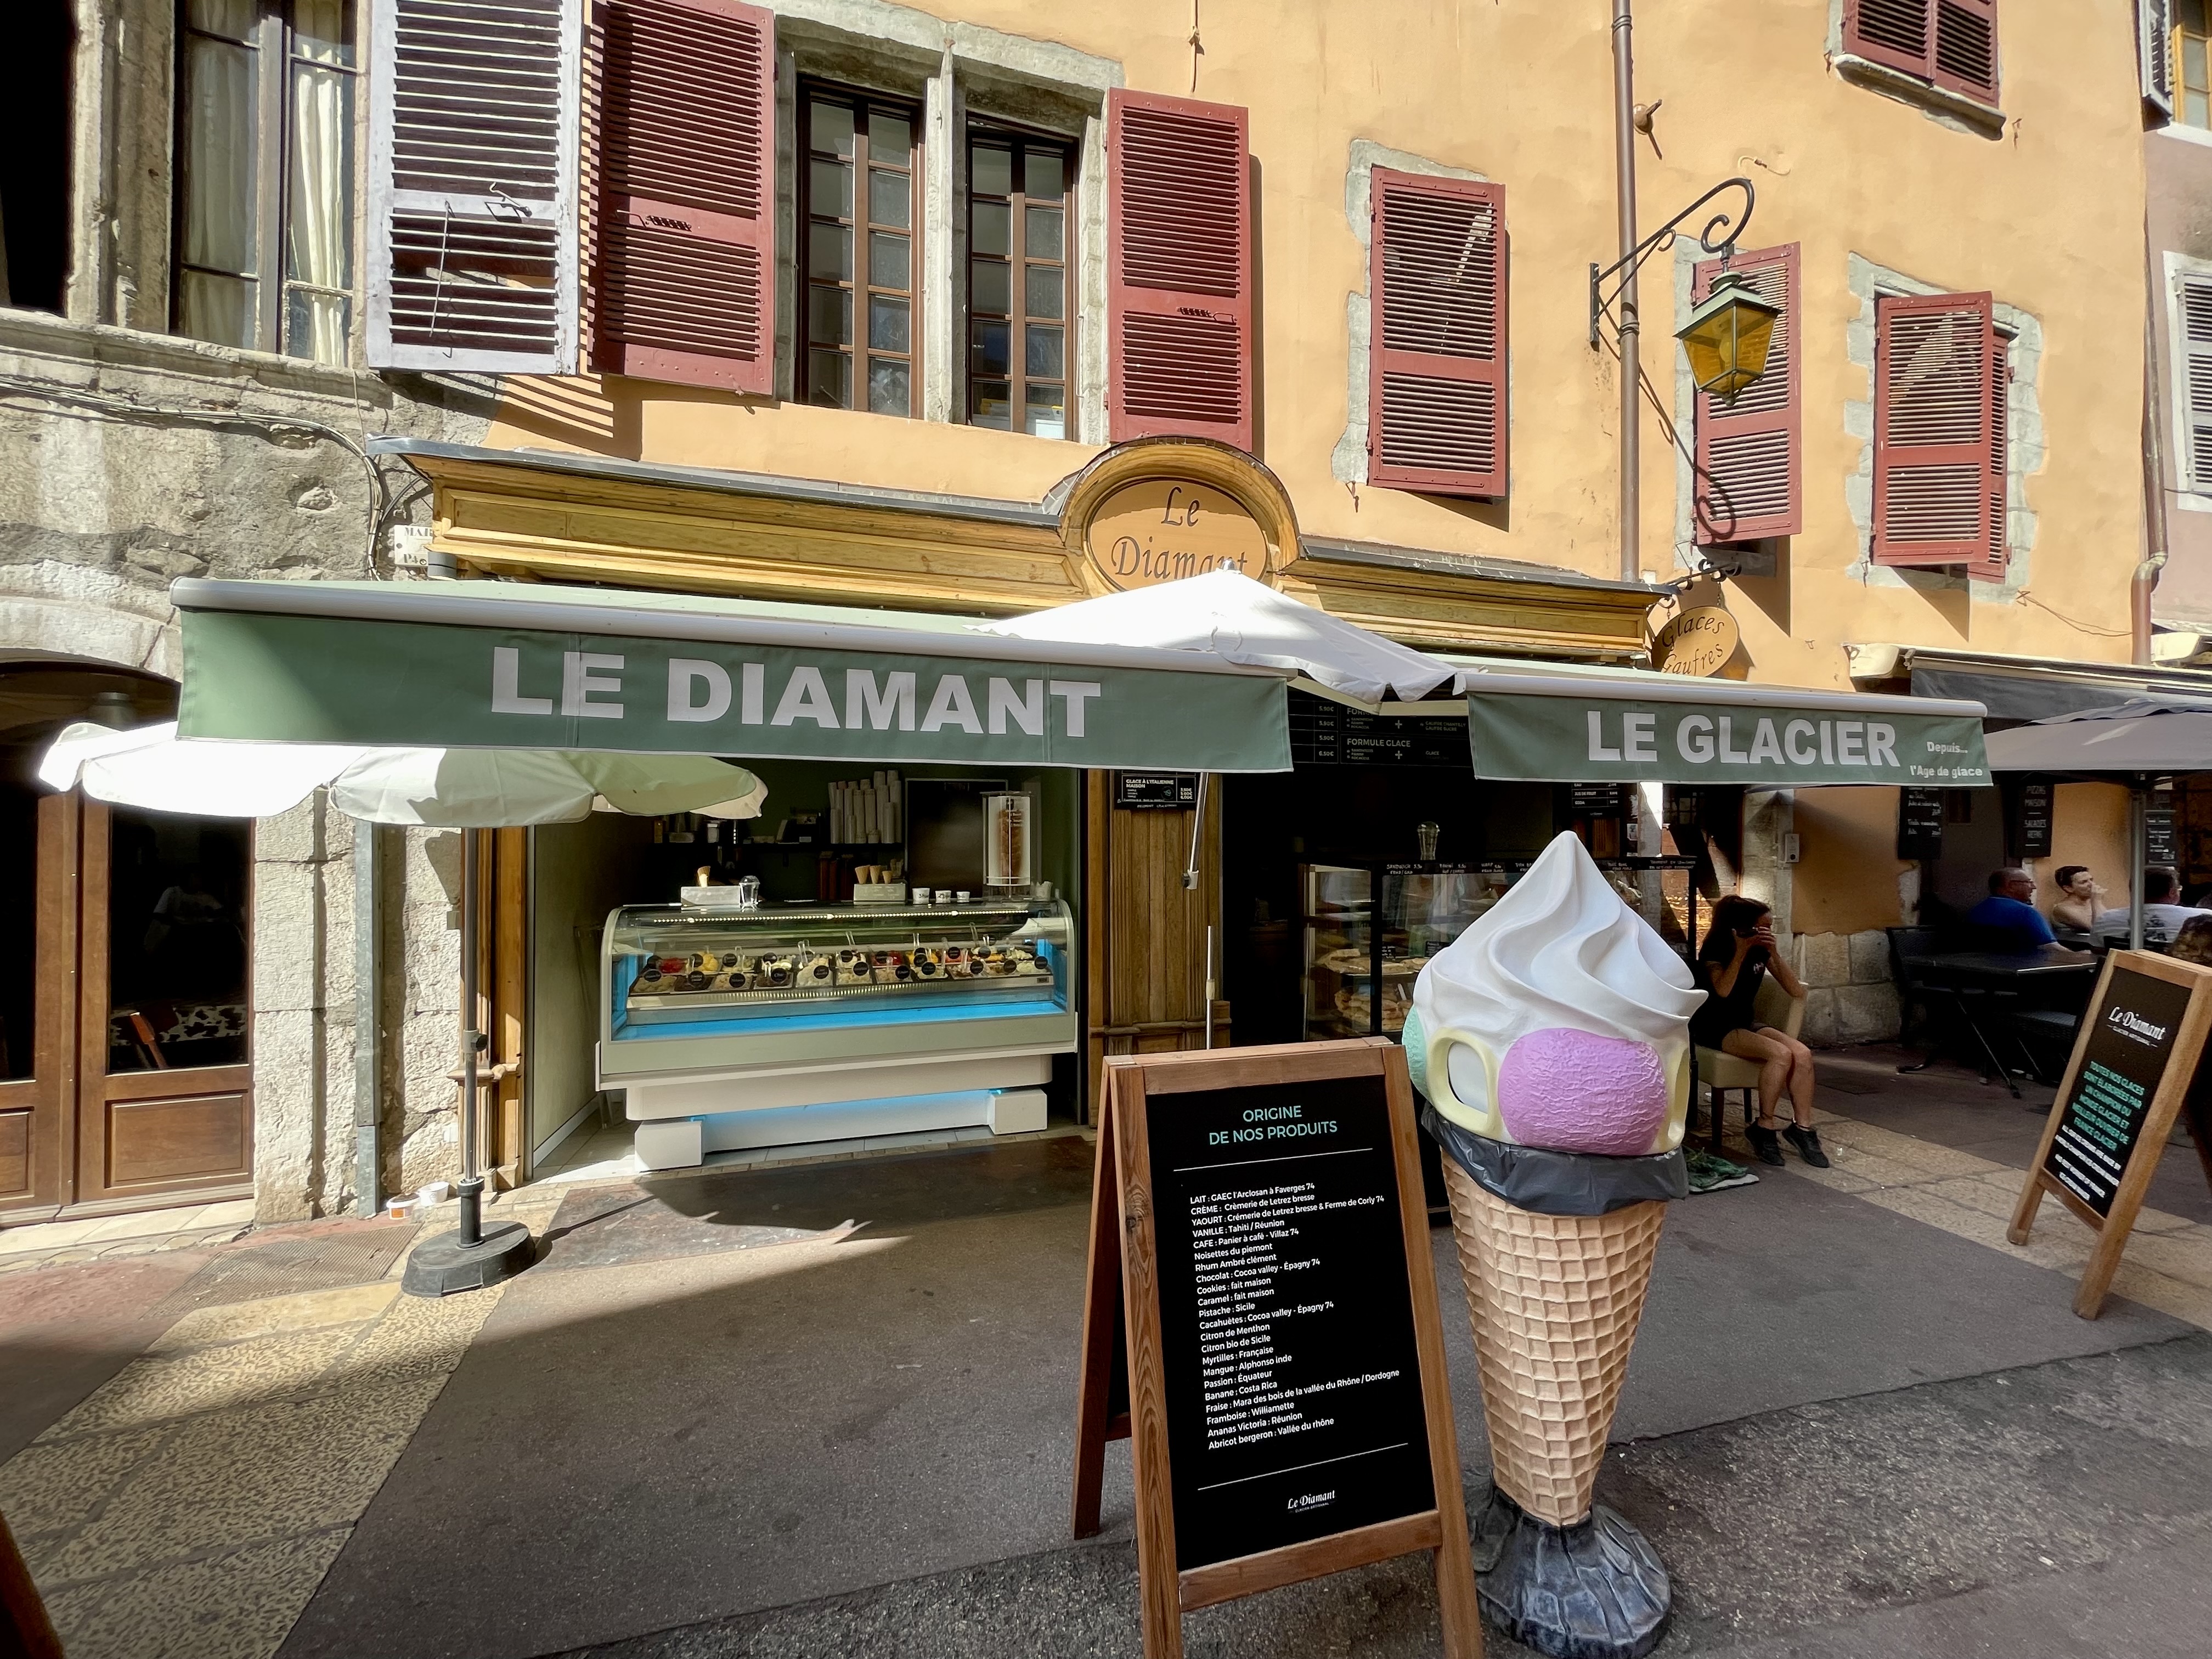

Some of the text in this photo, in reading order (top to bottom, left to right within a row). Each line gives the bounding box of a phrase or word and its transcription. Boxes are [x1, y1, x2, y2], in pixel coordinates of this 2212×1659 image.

[1160, 486, 1200, 527] Le
[1662, 613, 1725, 648] Glaces
[1662, 644, 1724, 676] Gaufres
[491, 646, 1101, 737] LE DIAMANT
[1347, 738, 1385, 747] FORMULE
[1587, 710, 1900, 767] LE GLACIER
[1909, 765, 1984, 779] l'Age de glace
[2108, 1007, 2123, 1022] Le
[2123, 1012, 2166, 1040] Diamant
[1243, 1105, 1302, 1122] ORIGINE
[1209, 1120, 1338, 1145] DE NOS PRODUITS
[1190, 1195, 1206, 1204] LAIT
[1211, 1192, 1232, 1201] GAEC
[1274, 1184, 1306, 1194] Faverges
[1190, 1205, 1218, 1215] CRÈME
[1259, 1199, 1268, 1207] de
[1269, 1197, 1291, 1205] Letrez
[1292, 1194, 1315, 1203] bresse
[1191, 1215, 1223, 1226] YAOURT
[1261, 1209, 1272, 1217] de
[1272, 1207, 1294, 1216] Letrez
[1295, 1205, 1318, 1213] bresse
[1324, 1201, 1347, 1209] Ferme
[1357, 1197, 1375, 1205] Corly
[1192, 1219, 1285, 1238] VANILLE Tahiti Réunion
[1193, 1239, 1214, 1249] CAFE
[1218, 1236, 1242, 1245] Panier
[1243, 1234, 1248, 1243] à
[1249, 1232, 1265, 1242] café
[1269, 1229, 1289, 1238] Villaz
[1194, 1243, 1273, 1260] Noisettes du piemont
[1195, 1254, 1277, 1272] Rhum Ambré clément
[1195, 1272, 1230, 1283] Chocolat
[1234, 1268, 1257, 1277] Cocoa
[1257, 1265, 1279, 1274] valley
[1311, 1258, 1321, 1266] 74
[1197, 1278, 1271, 1295] Cookies fait maison
[1198, 1289, 1274, 1306] Caramel fait maison
[1199, 1302, 1255, 1318] Pistache Sicile
[1199, 1317, 1243, 1329] Cacahuètes
[1247, 1312, 1271, 1322] Cocoa
[1271, 1308, 1292, 1318] valley
[1324, 1301, 1334, 1309] 74
[1200, 1324, 1270, 1341] Citron de Menthon
[1201, 1334, 1271, 1353] Citron bio de Sicile
[1202, 1346, 1274, 1366] Myrtilles Française
[1203, 1365, 1234, 1377] Mangue
[1239, 1358, 1274, 1371] Alphonso
[1204, 1378, 1233, 1389] Passion
[1205, 1381, 1278, 1401] Banane Costa Rica
[1205, 1370, 1400, 1413] Fraise Mara des bois de la vallée du Rhône Dordogne
[1206, 1402, 1295, 1425] Framboise Williamette
[1207, 1412, 1302, 1437] Ananas Victoria Réunion
[1208, 1418, 1334, 1450] Abricot bergeron Vallée du rhône
[1288, 1490, 1335, 1509] Le Diamant
